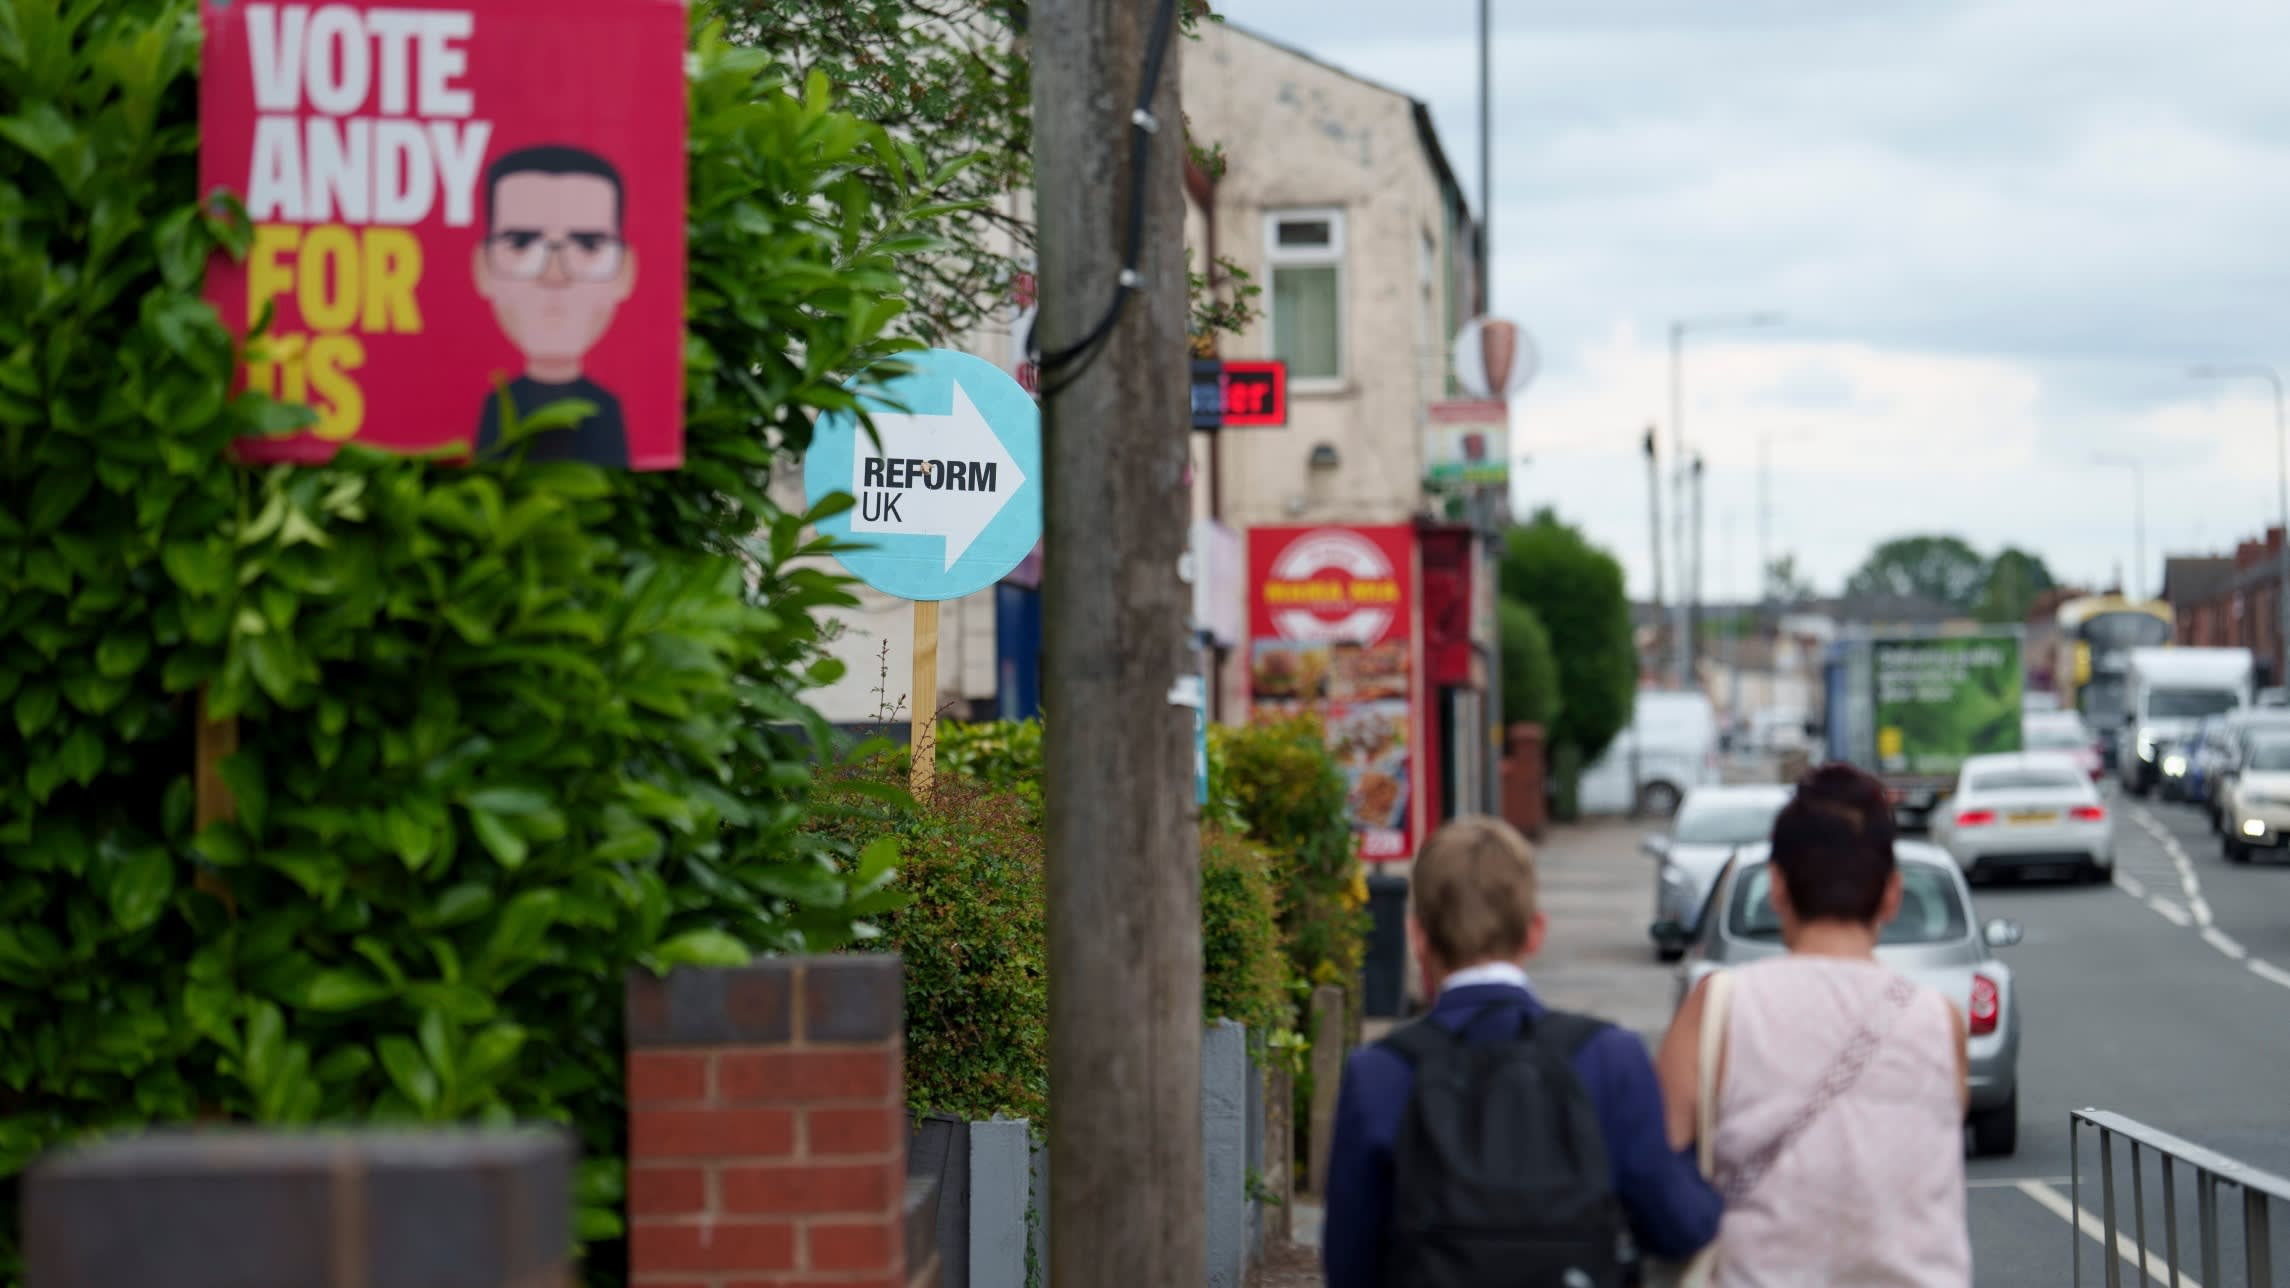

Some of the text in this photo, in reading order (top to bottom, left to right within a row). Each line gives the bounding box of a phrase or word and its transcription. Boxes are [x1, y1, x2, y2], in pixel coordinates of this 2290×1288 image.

[245, 3, 475, 117] VOTE
[246, 115, 493, 227] ANDY
[246, 225, 424, 333] FOR
[862, 491, 903, 522] UK
[863, 457, 997, 493] REFORM
